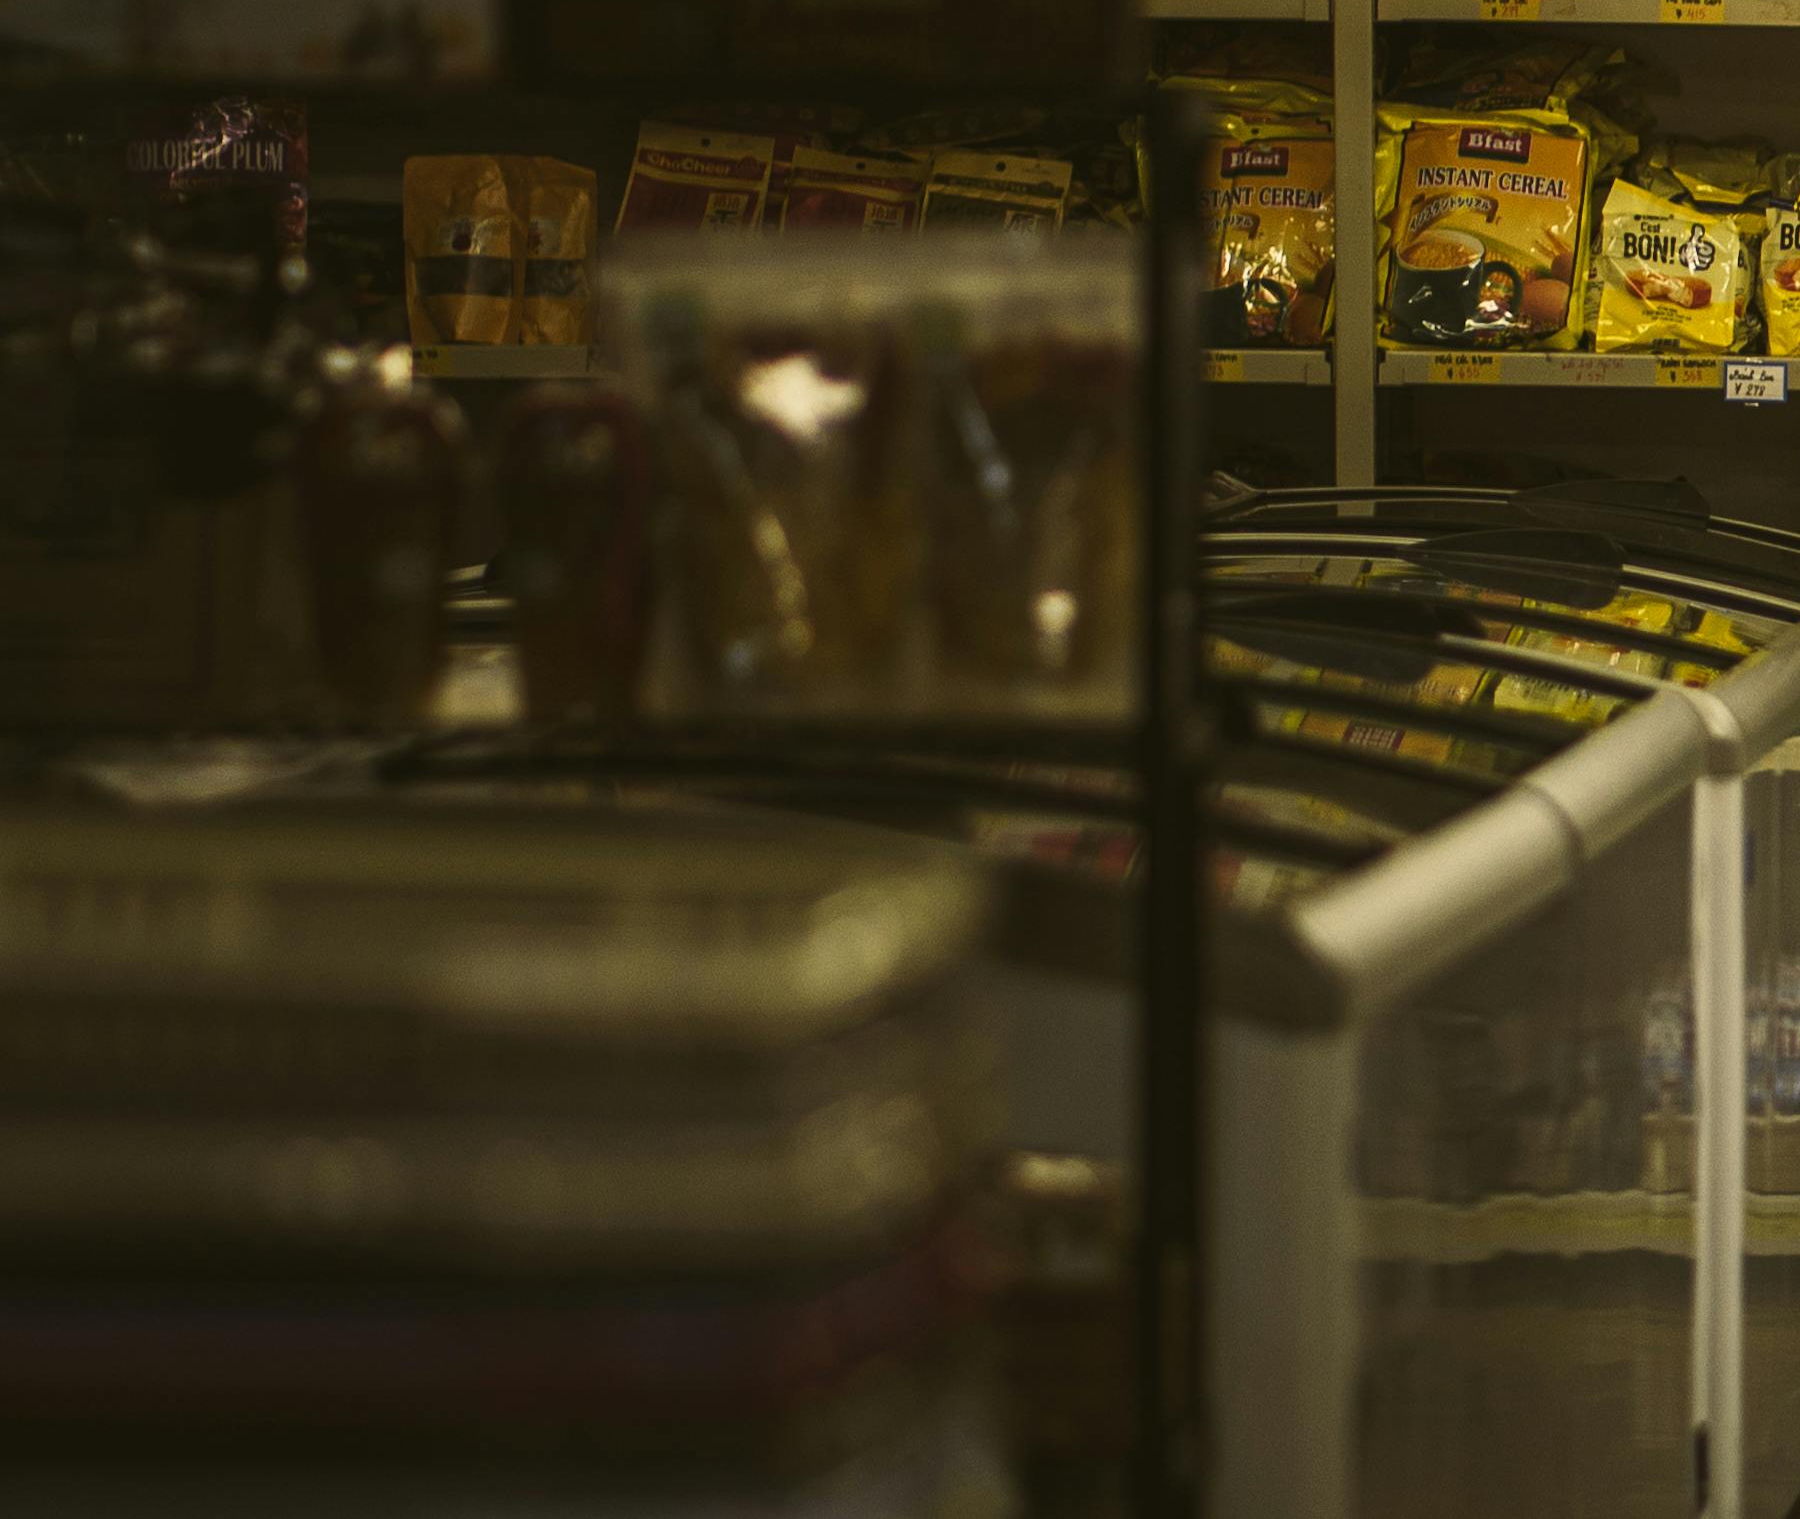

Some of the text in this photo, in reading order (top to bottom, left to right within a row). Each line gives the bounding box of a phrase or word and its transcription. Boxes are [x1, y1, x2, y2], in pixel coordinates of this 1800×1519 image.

[231, 138, 286, 173] PLUM
[1417, 165, 1570, 200] INSTANT CEREAL
[1622, 231, 1677, 262] BON!
